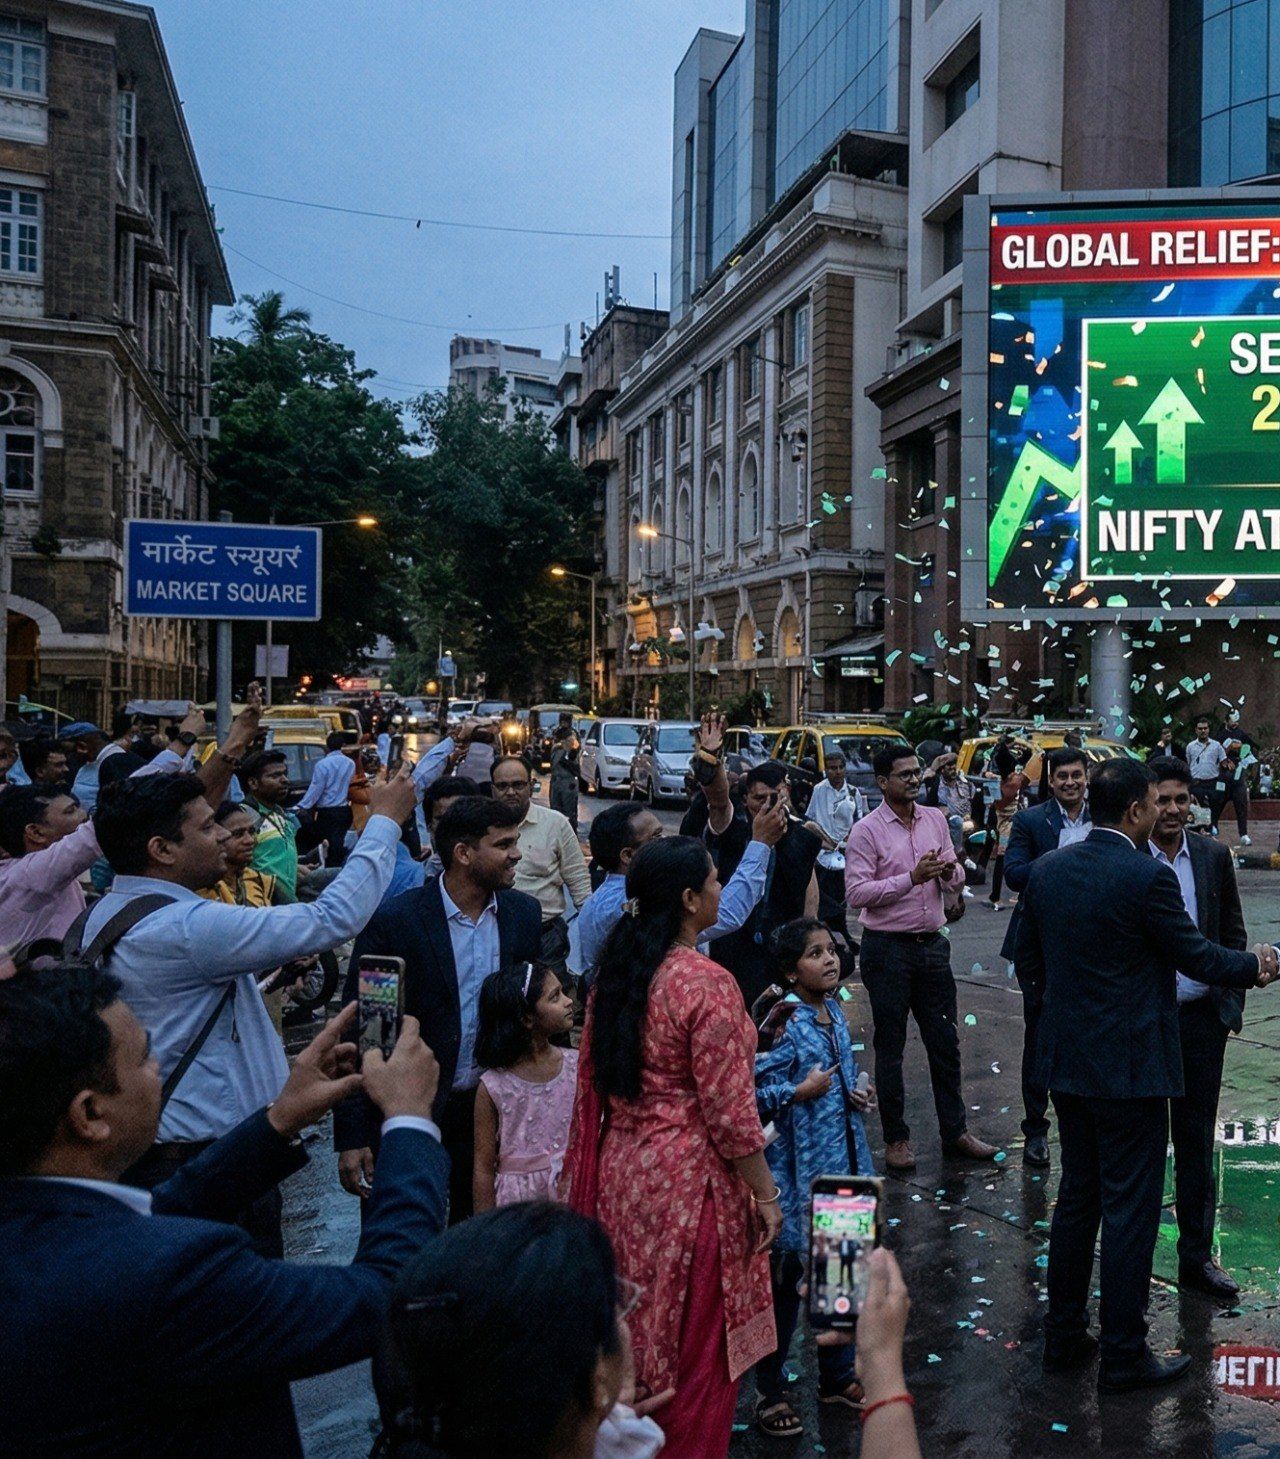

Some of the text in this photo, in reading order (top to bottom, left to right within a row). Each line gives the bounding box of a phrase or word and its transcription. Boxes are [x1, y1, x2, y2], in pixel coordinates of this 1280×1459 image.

[1001, 231, 1140, 271] GLOBAL
[1150, 228, 1280, 267] RELIEF:
[1099, 509, 1223, 552] NIFTY
[141, 534, 218, 565] मार्केट
[137, 579, 307, 604] MARKET SQUARE
